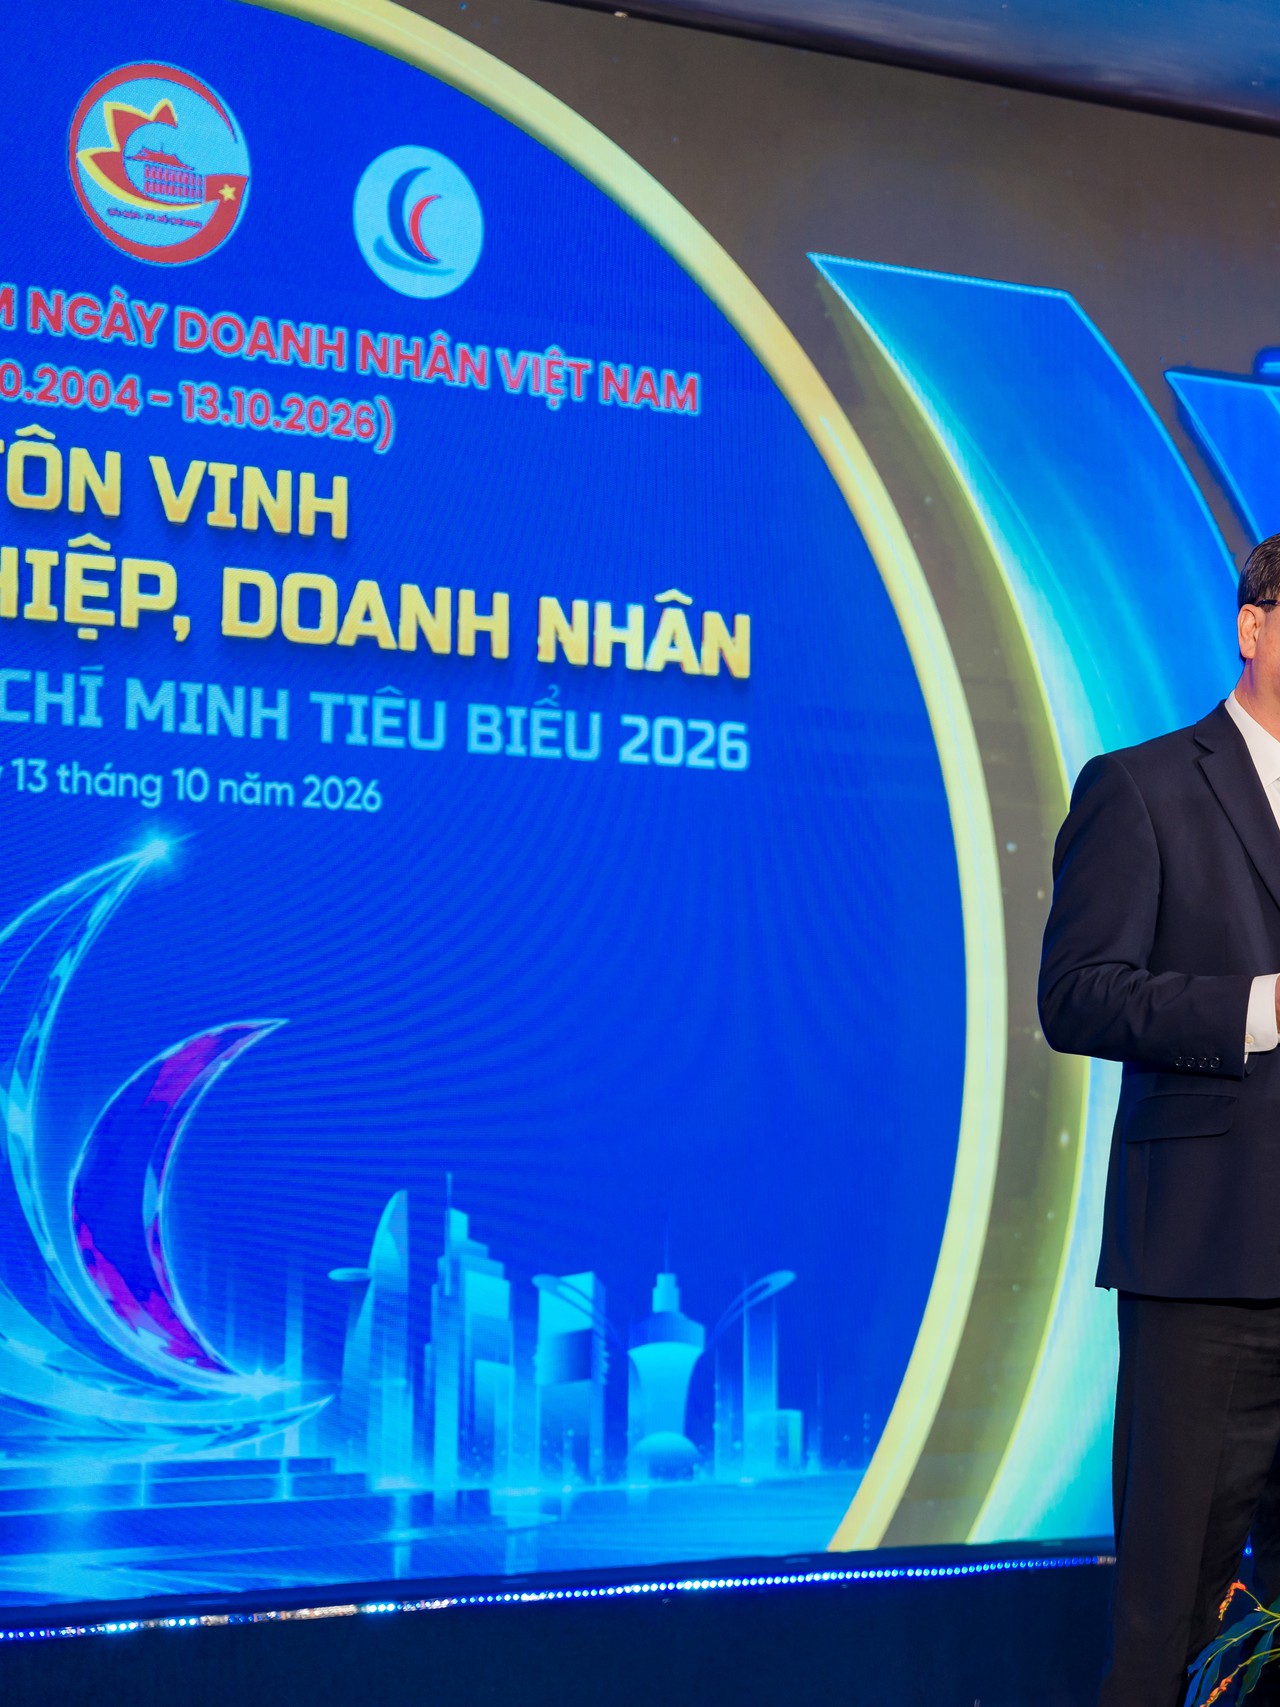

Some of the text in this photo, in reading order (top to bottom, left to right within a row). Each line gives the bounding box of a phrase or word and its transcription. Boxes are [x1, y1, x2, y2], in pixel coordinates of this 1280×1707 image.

[28, 286, 165, 346] NGÀY
[176, 308, 347, 369] DOANH
[357, 331, 489, 388] NHÂN
[498, 347, 593, 408] VIỆT
[601, 364, 699, 413] NAM
[181, 382, 394, 452] 13.10.2026)
[0, 423, 348, 540] ÔN VINH
[220, 566, 510, 660] DOANH
[536, 588, 751, 680] NHÂN
[0, 665, 750, 771] CHÍ MINH TIÊU BIỂU 2026
[11, 757, 48, 794] 13
[55, 761, 164, 809] tháng
[171, 767, 211, 803] 10
[217, 771, 295, 807] năm
[301, 774, 383, 813] 2026
